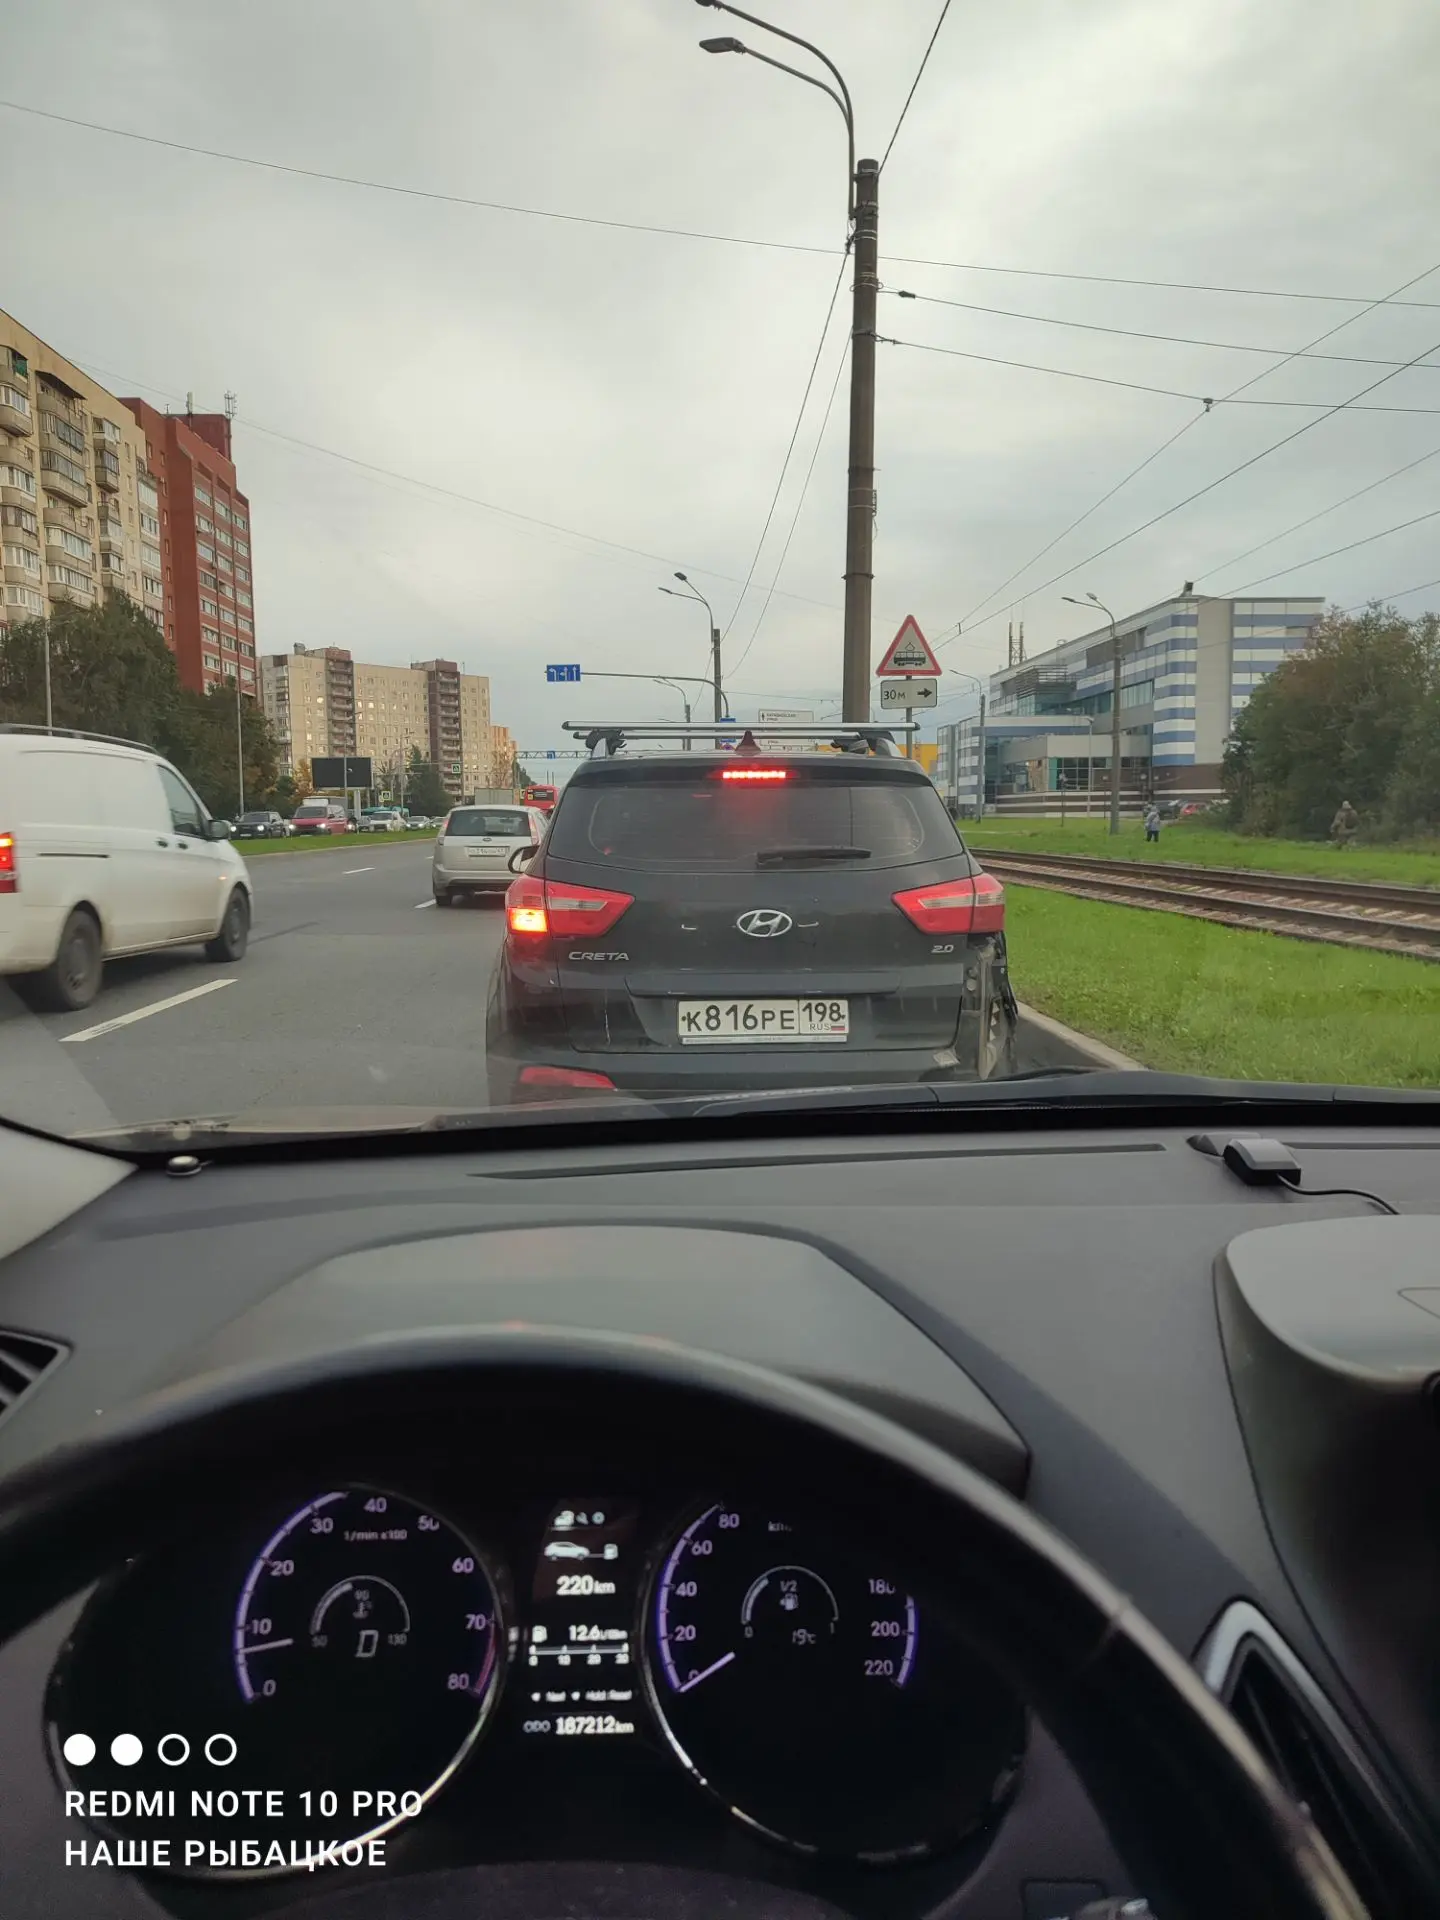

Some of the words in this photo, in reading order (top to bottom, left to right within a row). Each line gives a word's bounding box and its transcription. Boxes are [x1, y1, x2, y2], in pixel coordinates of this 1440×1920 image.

[568, 951, 630, 961] CRETA
[802, 1002, 841, 1022] 198
[363, 1497, 387, 1512] 40
[310, 1517, 334, 1534] 30
[718, 1513, 740, 1529] 80
[691, 1540, 713, 1556] 60
[270, 1559, 295, 1576] 20
[451, 1557, 474, 1573] 60
[675, 1581, 698, 1597] 40
[251, 1617, 273, 1635] 10
[464, 1614, 487, 1630] 70
[870, 1621, 901, 1637] 200
[674, 1625, 697, 1642] 20
[864, 1659, 894, 1676] 220
[262, 1679, 277, 1697] 0
[447, 1673, 470, 1690] 80
